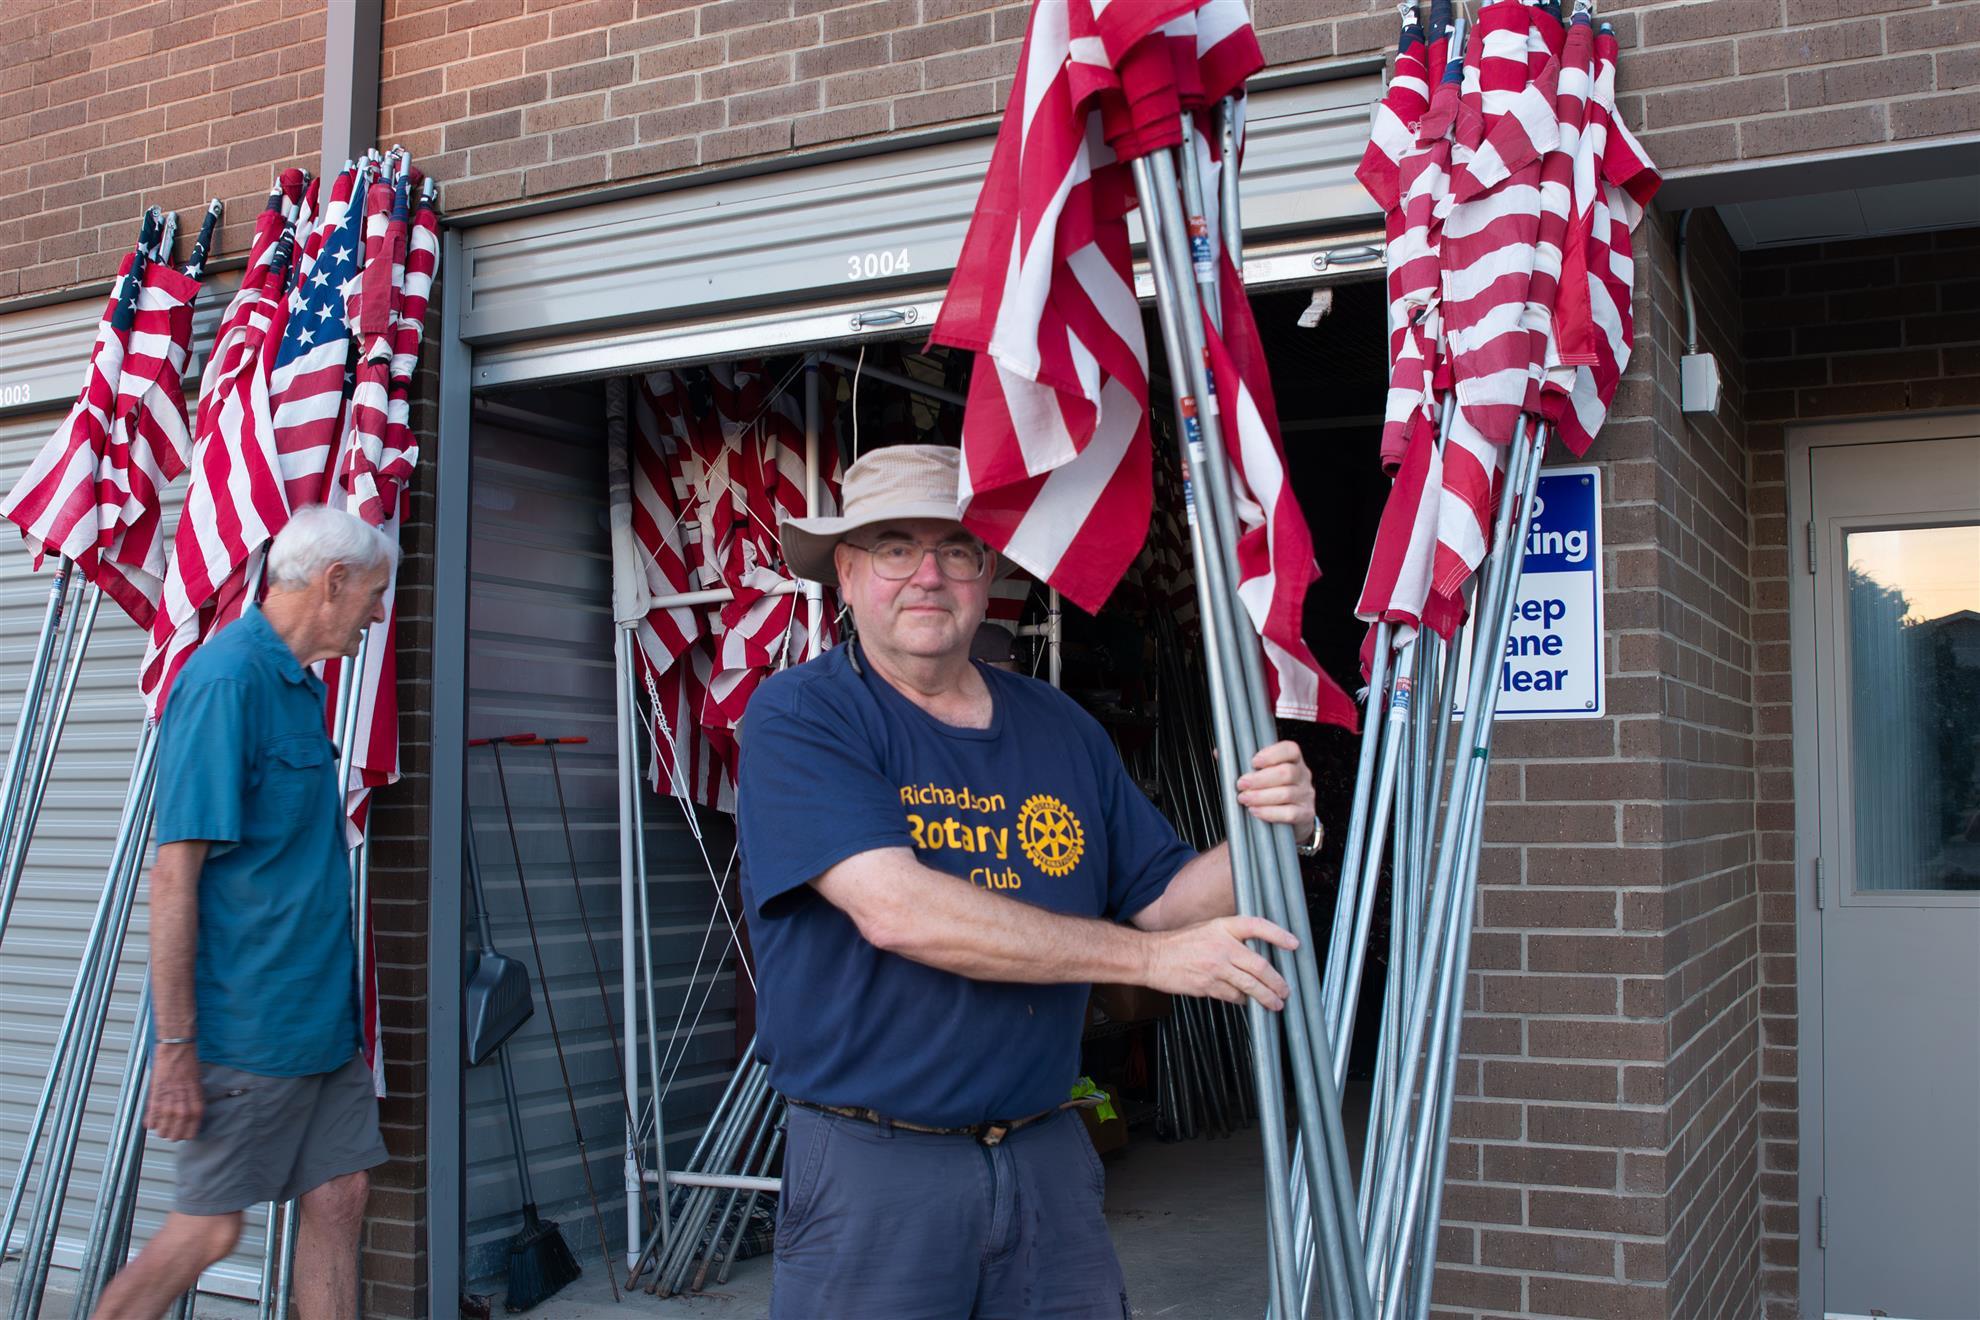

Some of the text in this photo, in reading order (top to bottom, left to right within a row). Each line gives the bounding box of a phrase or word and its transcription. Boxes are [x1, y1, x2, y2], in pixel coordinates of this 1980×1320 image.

[848, 247, 911, 280] 3004
[1506, 634, 1563, 657] ane
[1500, 661, 1568, 692] lear
[907, 814, 1009, 859] Rotary
[970, 867, 1021, 889] Club
